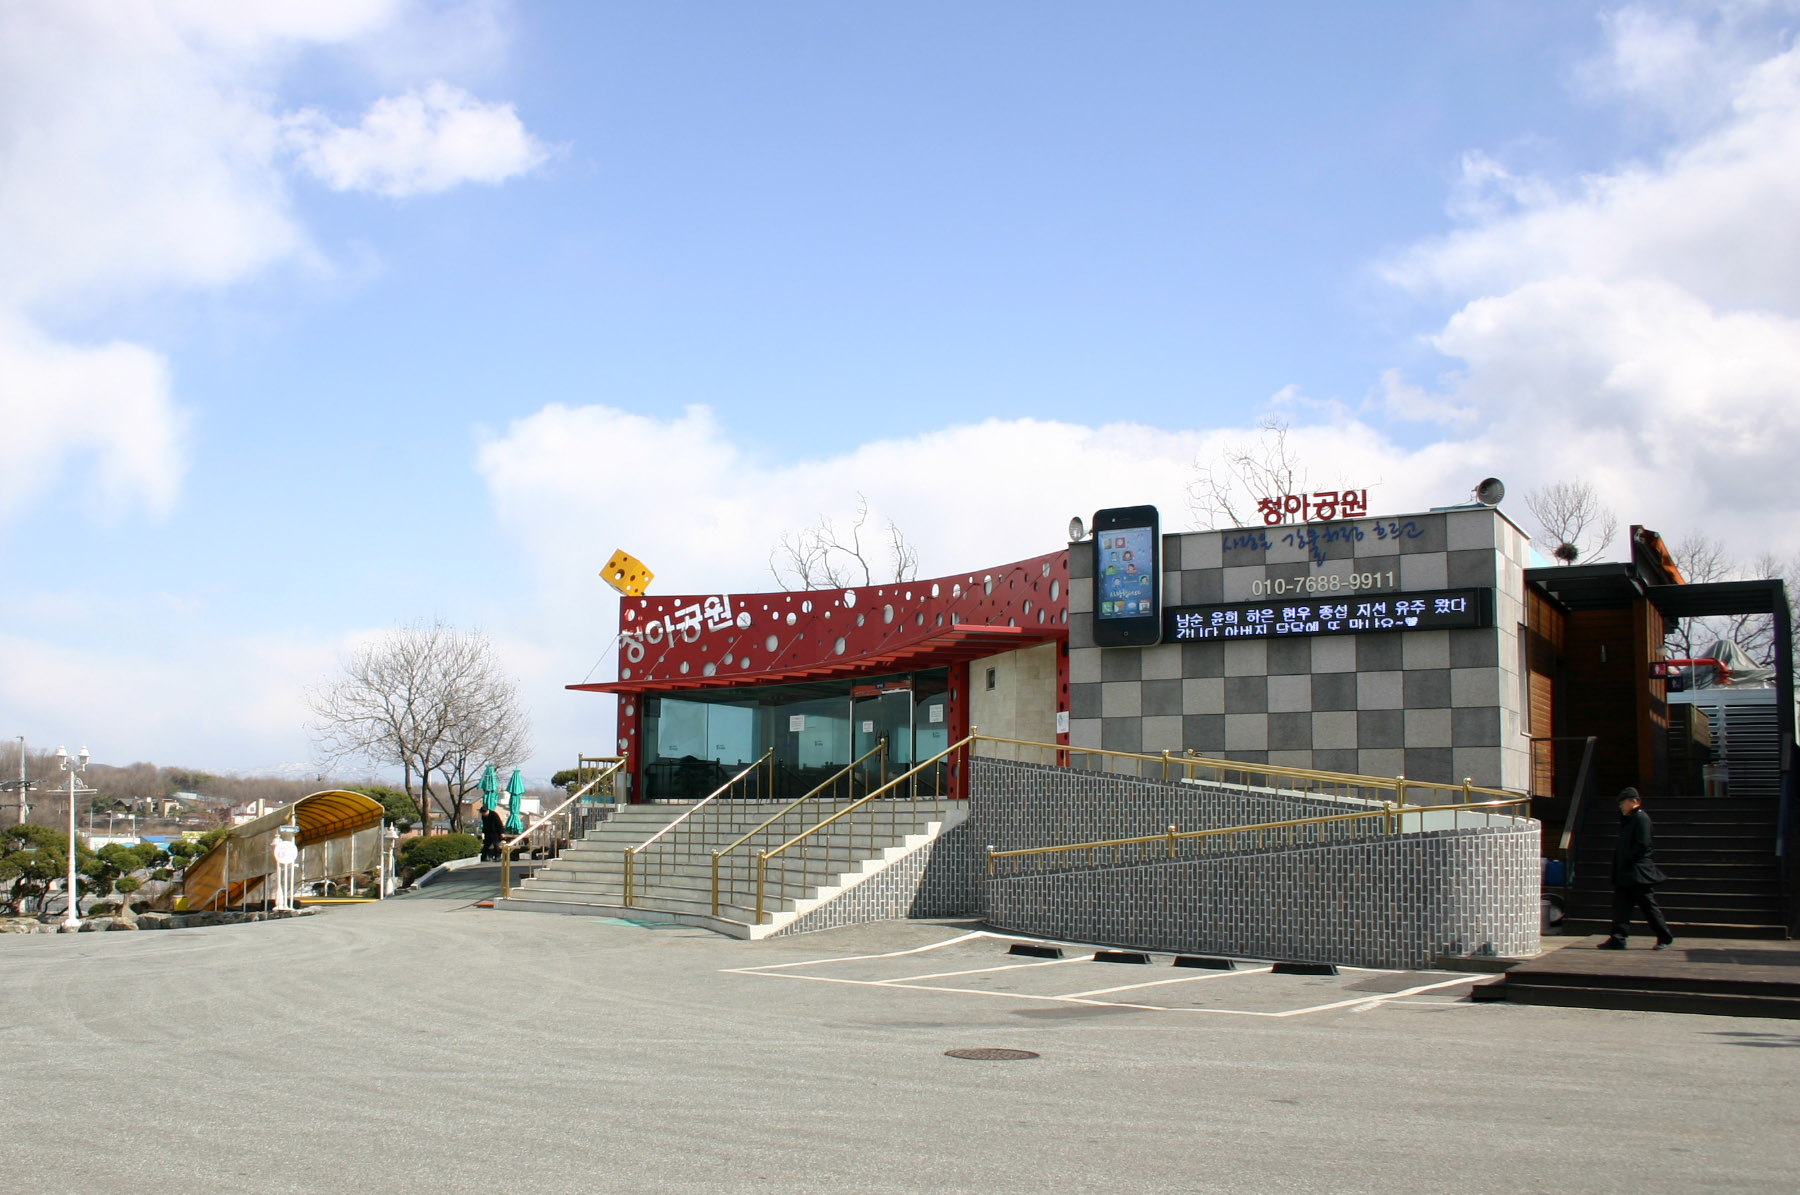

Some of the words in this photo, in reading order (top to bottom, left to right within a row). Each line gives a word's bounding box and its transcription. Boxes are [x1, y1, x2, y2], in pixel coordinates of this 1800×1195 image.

[1258, 489, 1367, 526] 청아공원
[1223, 532, 1272, 552] 사랑을
[1281, 526, 1364, 567] 강물처럼
[1373, 521, 1424, 540] 흐르고
[1252, 571, 1395, 596] 010-7688-9911
[1176, 613, 1204, 628] 남순
[1211, 610, 1238, 626] 윤희
[1246, 608, 1275, 623] 하은
[1282, 606, 1311, 622] 현우
[1319, 604, 1348, 620] 종섭
[1356, 601, 1386, 618] 지선
[1395, 599, 1426, 616] 유주
[1434, 597, 1467, 614] 왔다
